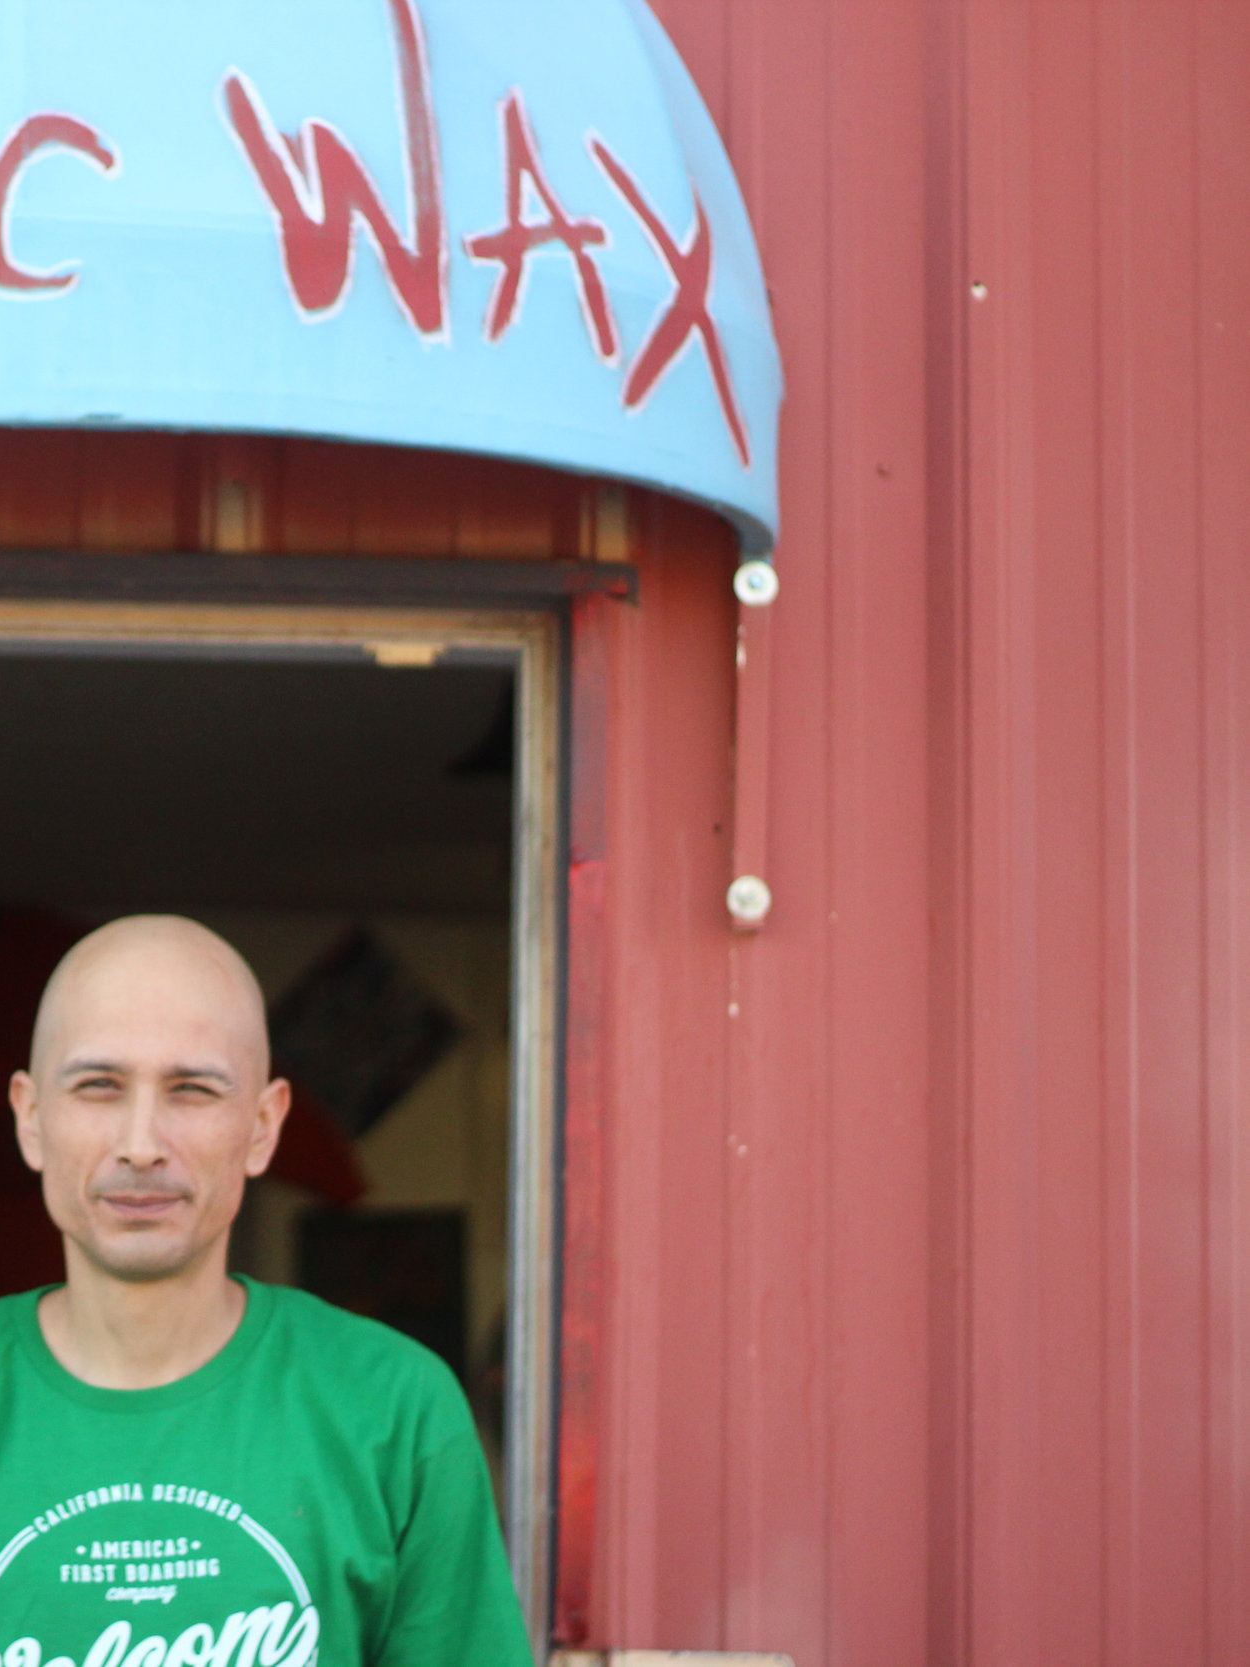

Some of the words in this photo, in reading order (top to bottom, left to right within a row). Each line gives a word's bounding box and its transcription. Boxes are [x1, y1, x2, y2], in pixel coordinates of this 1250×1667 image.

[218, 0, 750, 469] WAX
[34, 1483, 145, 1533] CALIFORNIA
[152, 1484, 243, 1522] DESIGNED
[89, 1536, 189, 1560] AMERICAS
[60, 1563, 117, 1583] FIRST
[125, 1557, 221, 1583] BOARDING
